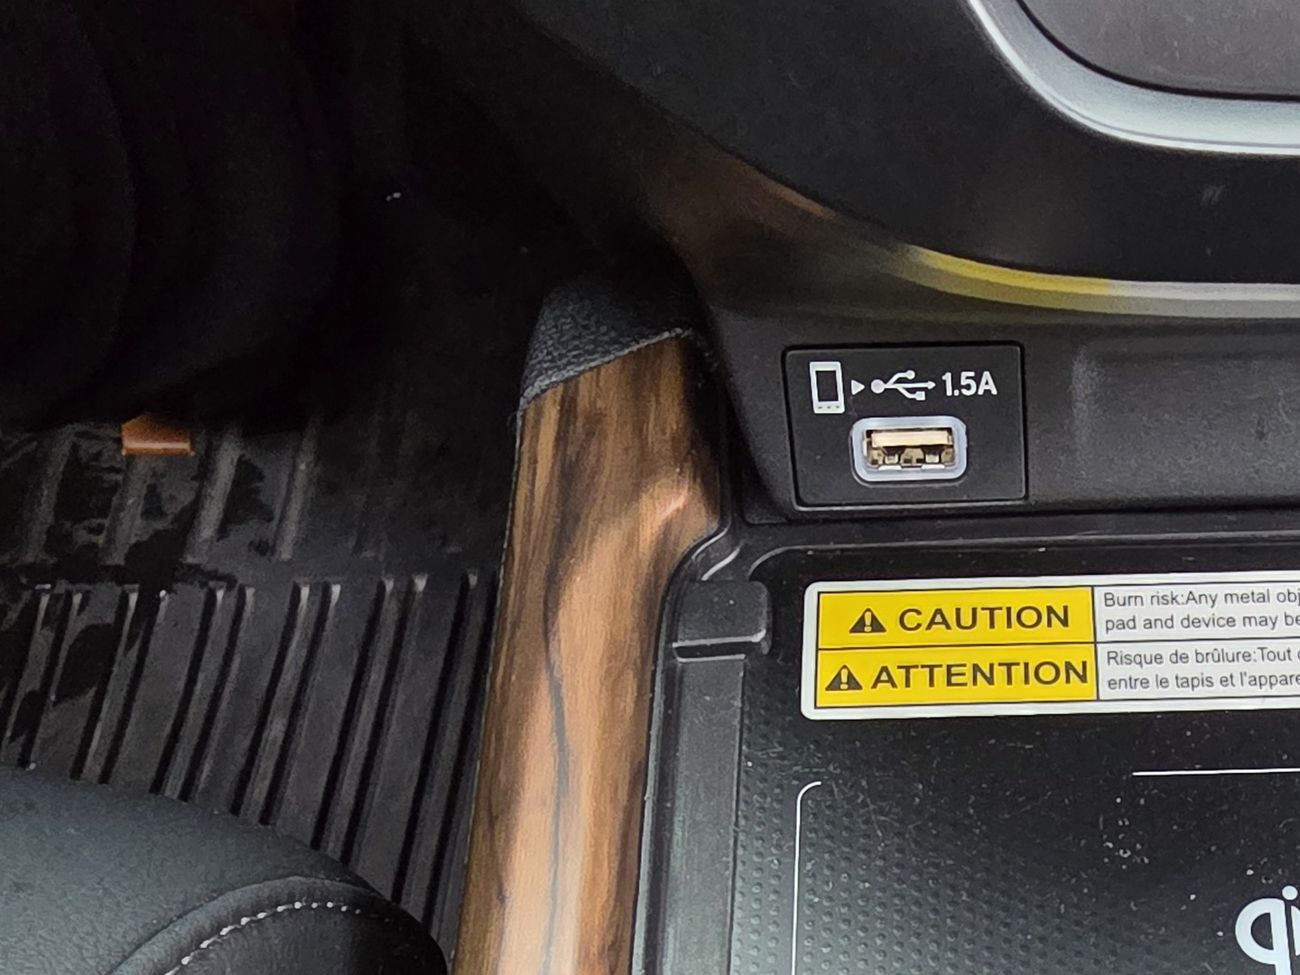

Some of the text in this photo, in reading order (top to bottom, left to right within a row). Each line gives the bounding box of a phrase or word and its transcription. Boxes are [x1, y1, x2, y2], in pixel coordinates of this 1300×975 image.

[942, 370, 998, 397] 1.5A
[1103, 591, 1144, 608] Burn
[1224, 588, 1271, 604] metal
[898, 604, 1070, 632] CAUTION
[1105, 615, 1137, 634] pad
[1143, 614, 1175, 630] and
[1180, 613, 1237, 629] device
[1242, 614, 1279, 631] may
[1106, 650, 1164, 669] Risque
[1169, 649, 1190, 665] de
[870, 660, 1089, 690] ATTENTION
[1107, 674, 1150, 691] entre
[1155, 674, 1170, 689] le
[1175, 672, 1215, 692] tapis
[1219, 673, 1236, 688] et
